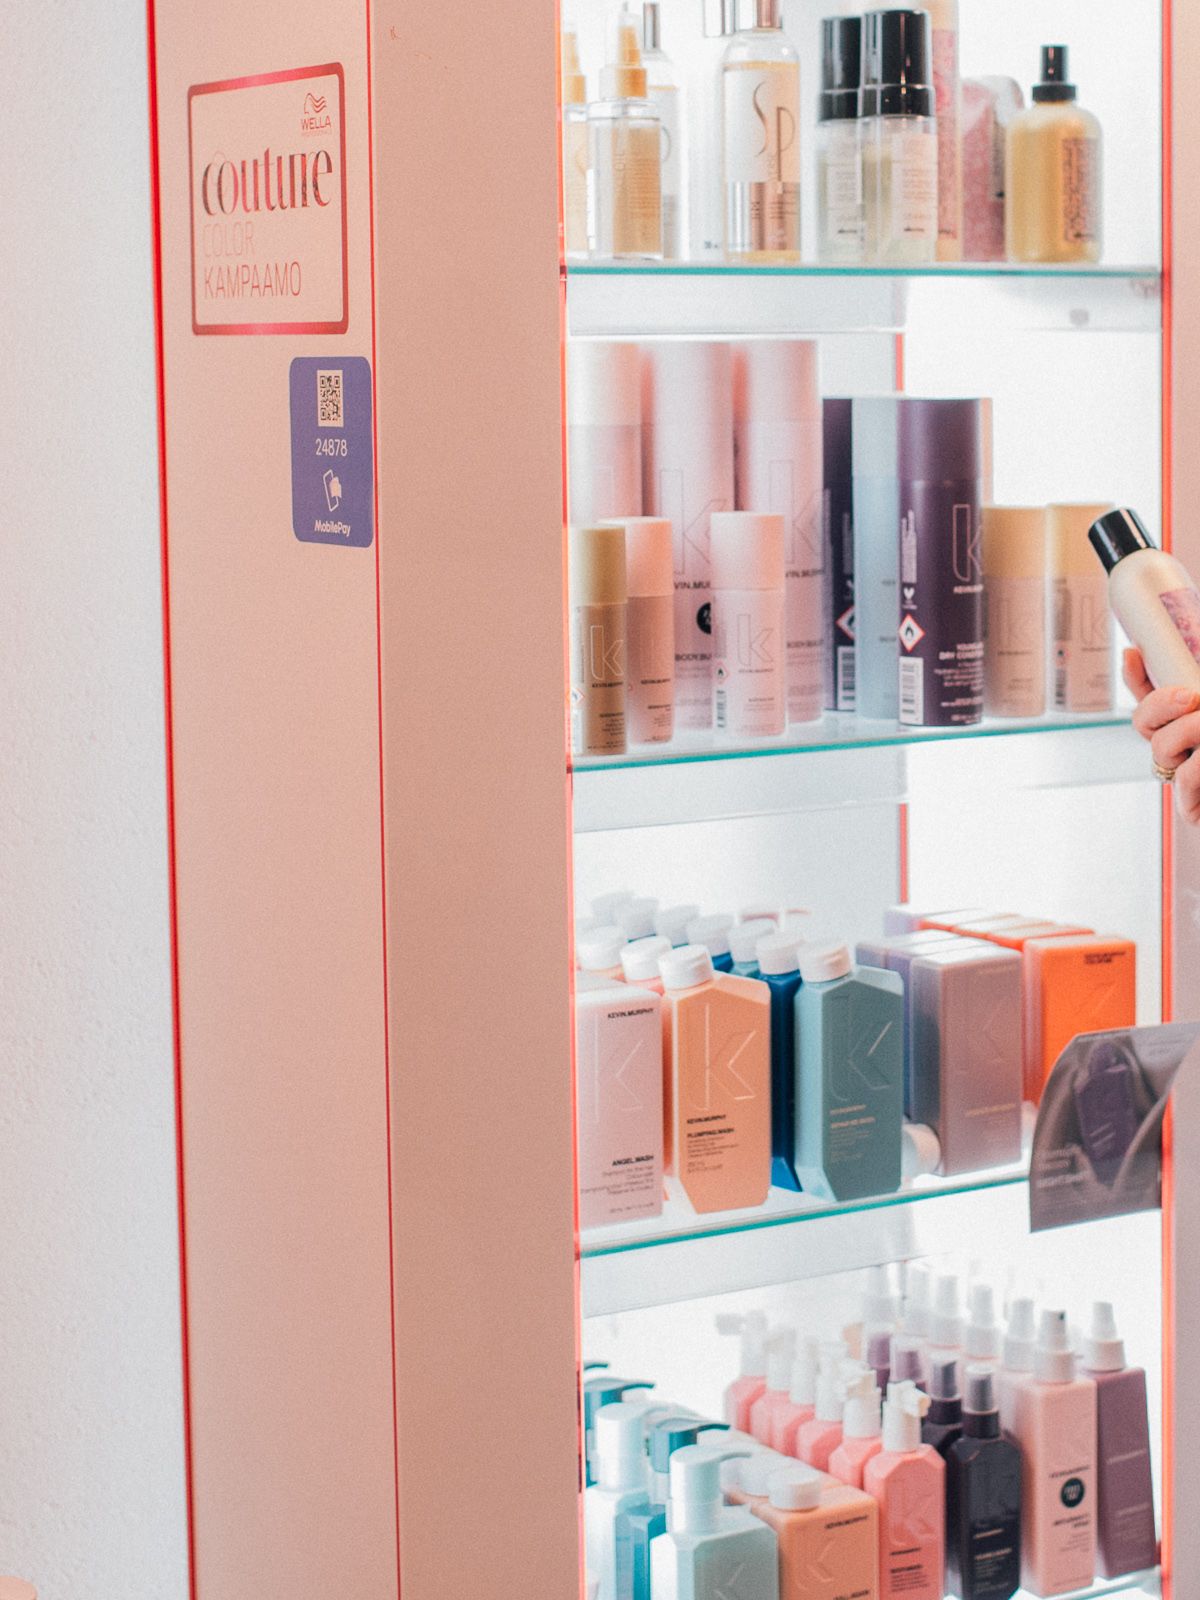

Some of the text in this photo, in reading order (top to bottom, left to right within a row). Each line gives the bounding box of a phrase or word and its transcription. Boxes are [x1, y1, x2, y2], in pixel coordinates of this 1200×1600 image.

[301, 115, 332, 130] WELLA
[202, 148, 333, 216] couture
[203, 221, 255, 258] COLOR
[203, 261, 302, 299] KAMPAAMO
[315, 438, 348, 457] 24878
[314, 519, 351, 537] MobilePay
[607, 1007, 654, 1019] KEVIN.MURPHY
